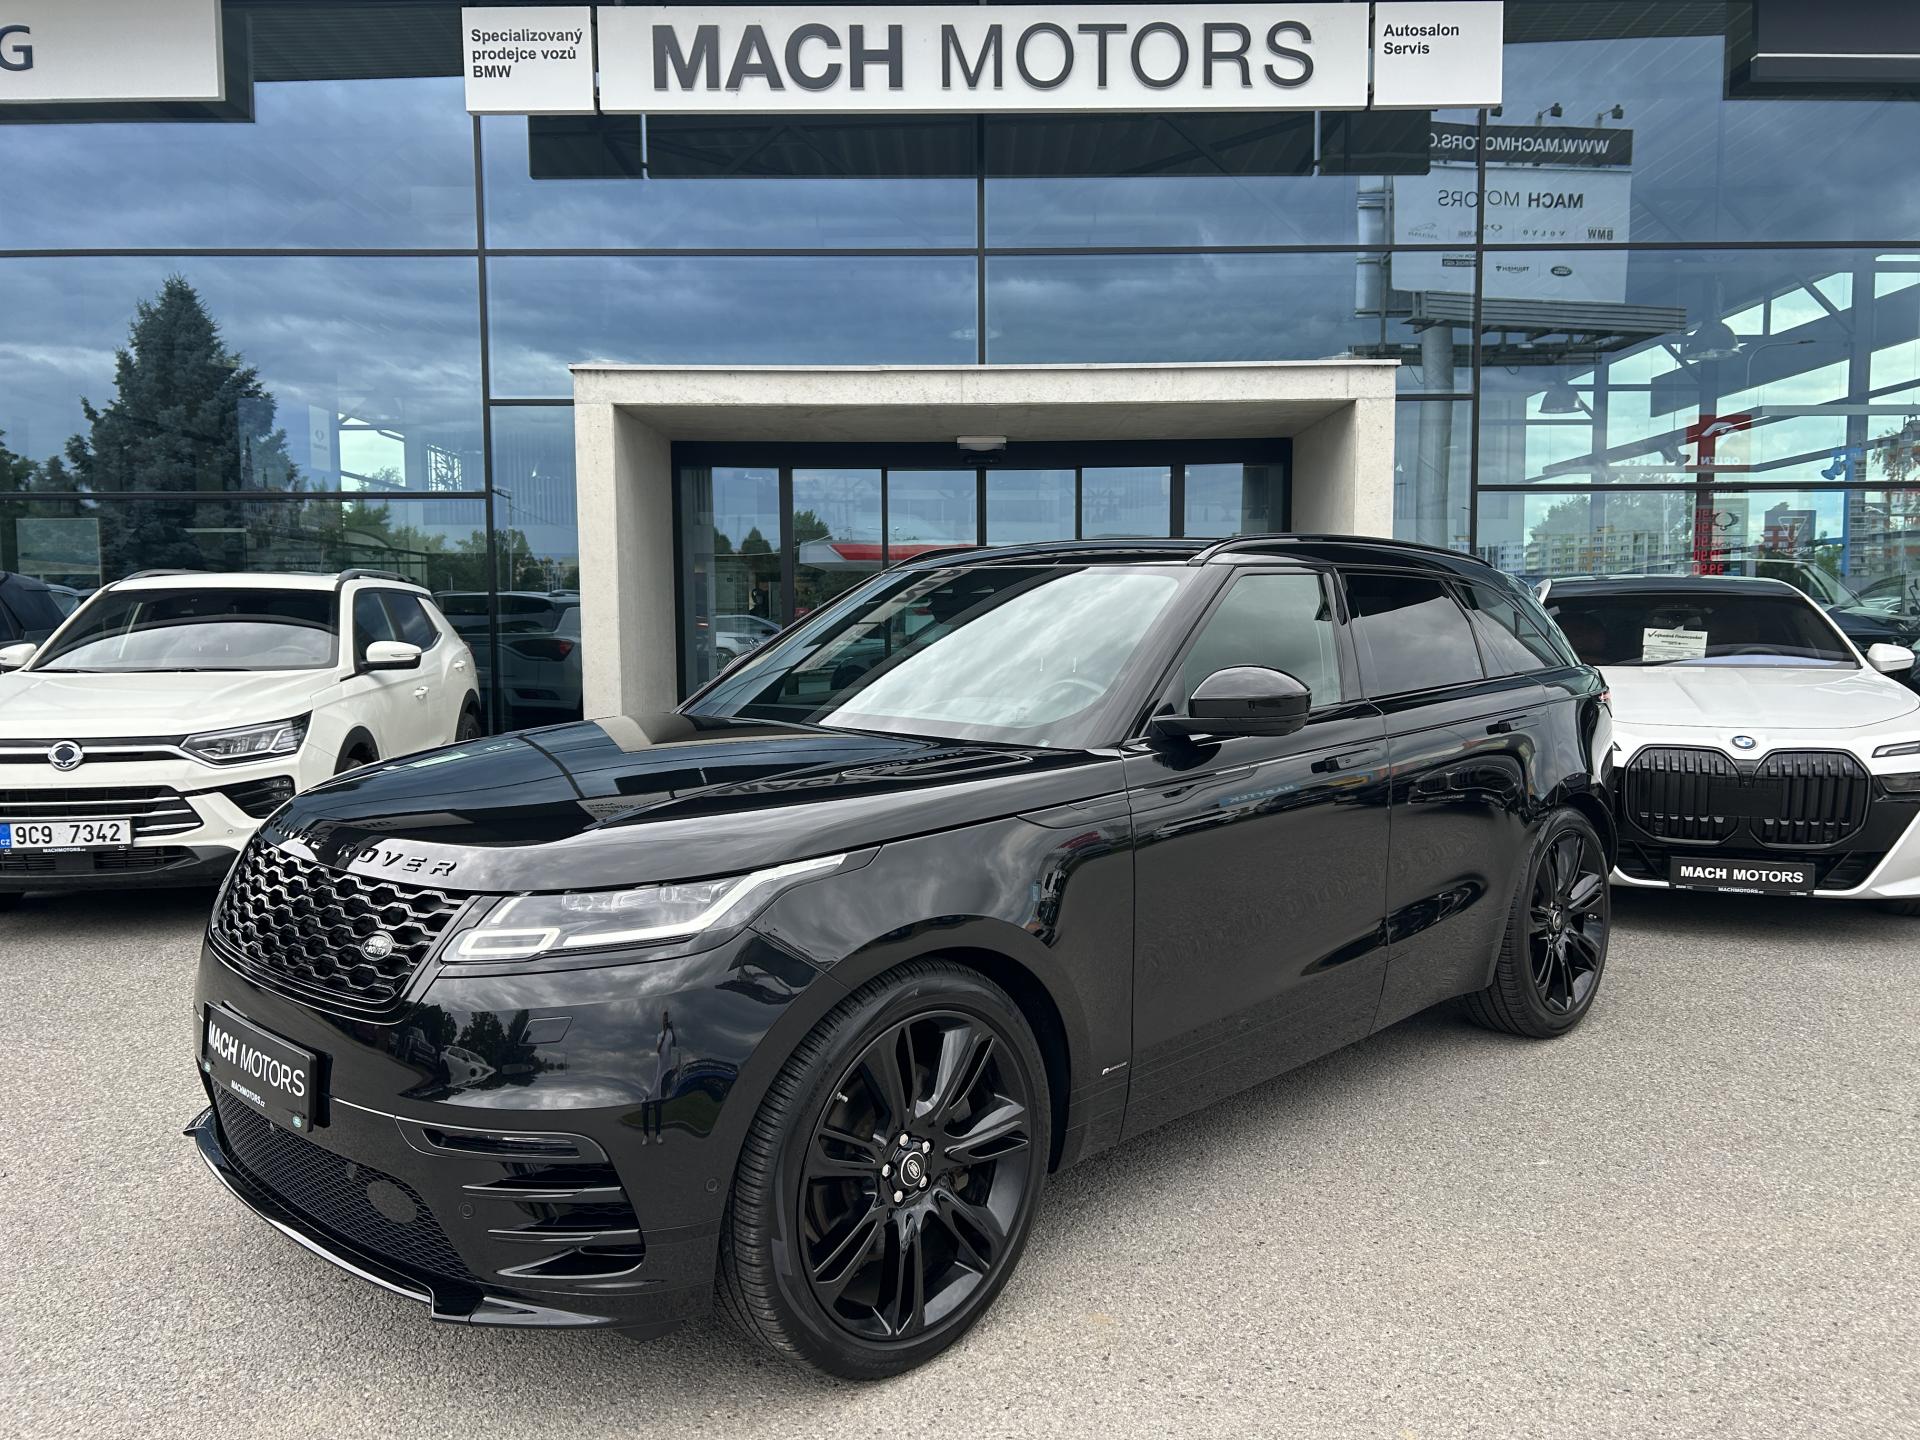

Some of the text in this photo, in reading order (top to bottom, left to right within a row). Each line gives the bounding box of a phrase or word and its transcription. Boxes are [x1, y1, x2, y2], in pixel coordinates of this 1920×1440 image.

[471, 28, 583, 45] Specializovaný
[1383, 23, 1460, 38] Autosalon
[472, 46, 577, 63] prodejce vozů
[652, 20, 1315, 91] MACH MOTORS
[1383, 41, 1430, 55] Servis
[473, 65, 512, 79] BMW
[15, 825, 52, 845] 9C9
[69, 823, 121, 844] 7342
[1680, 865, 1804, 883] MACH MOTORS
[208, 1020, 305, 1097] MACH MOTORS
